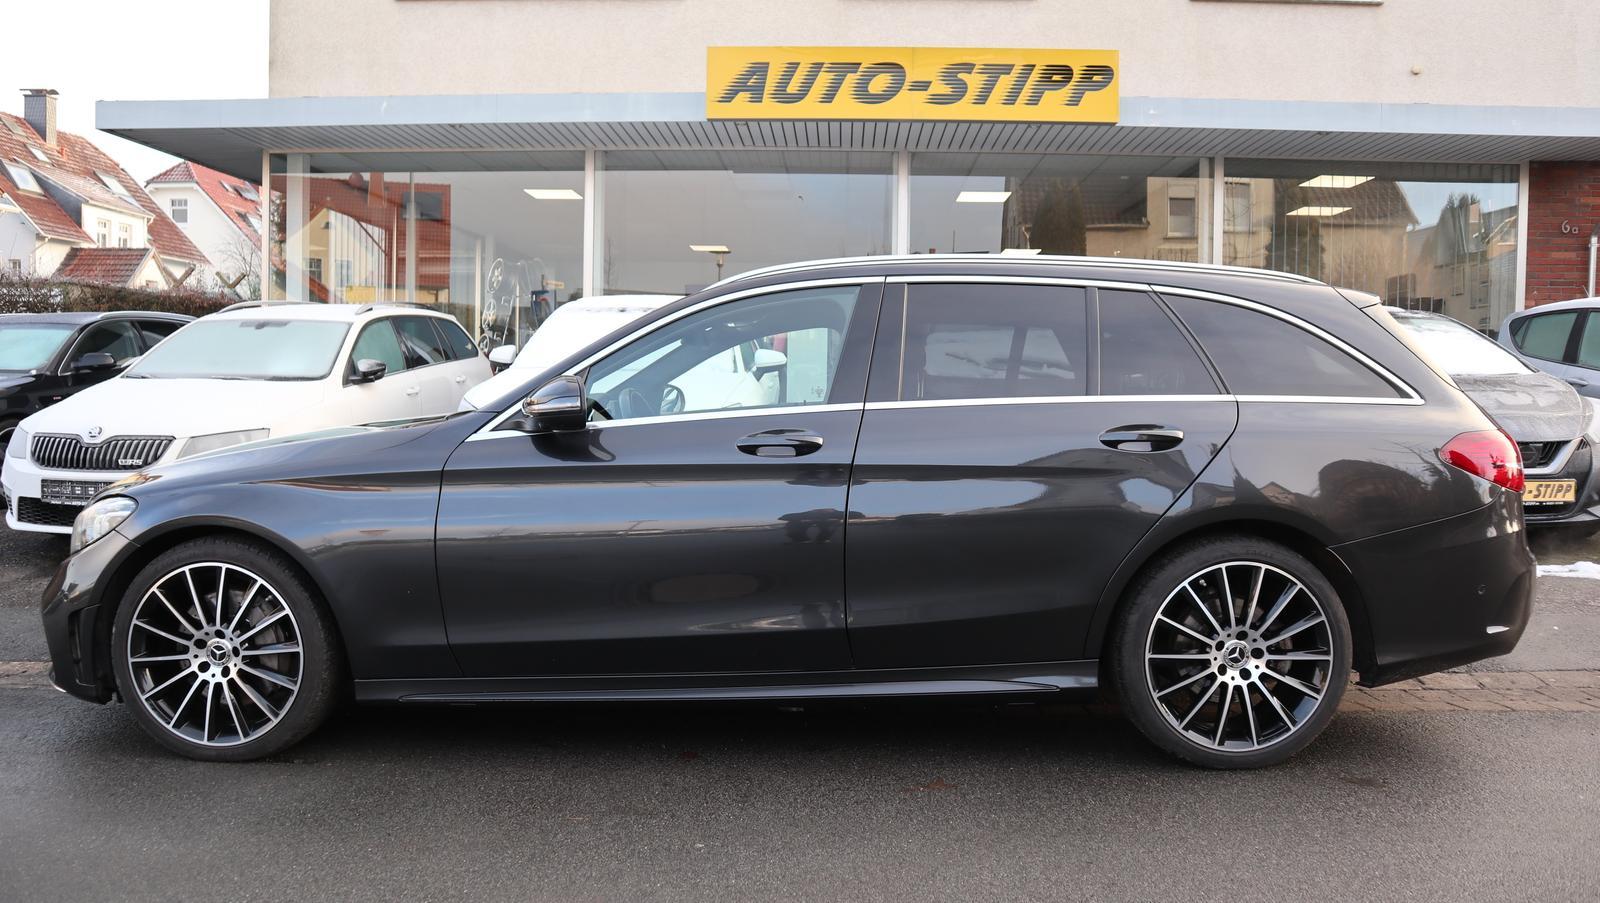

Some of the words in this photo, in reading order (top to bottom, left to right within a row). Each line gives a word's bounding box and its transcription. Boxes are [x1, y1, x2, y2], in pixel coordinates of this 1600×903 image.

[713, 61, 1115, 106] AUTO-STIPP
[1561, 220, 1579, 234] 6a
[1523, 484, 1572, 499] -STIPP
